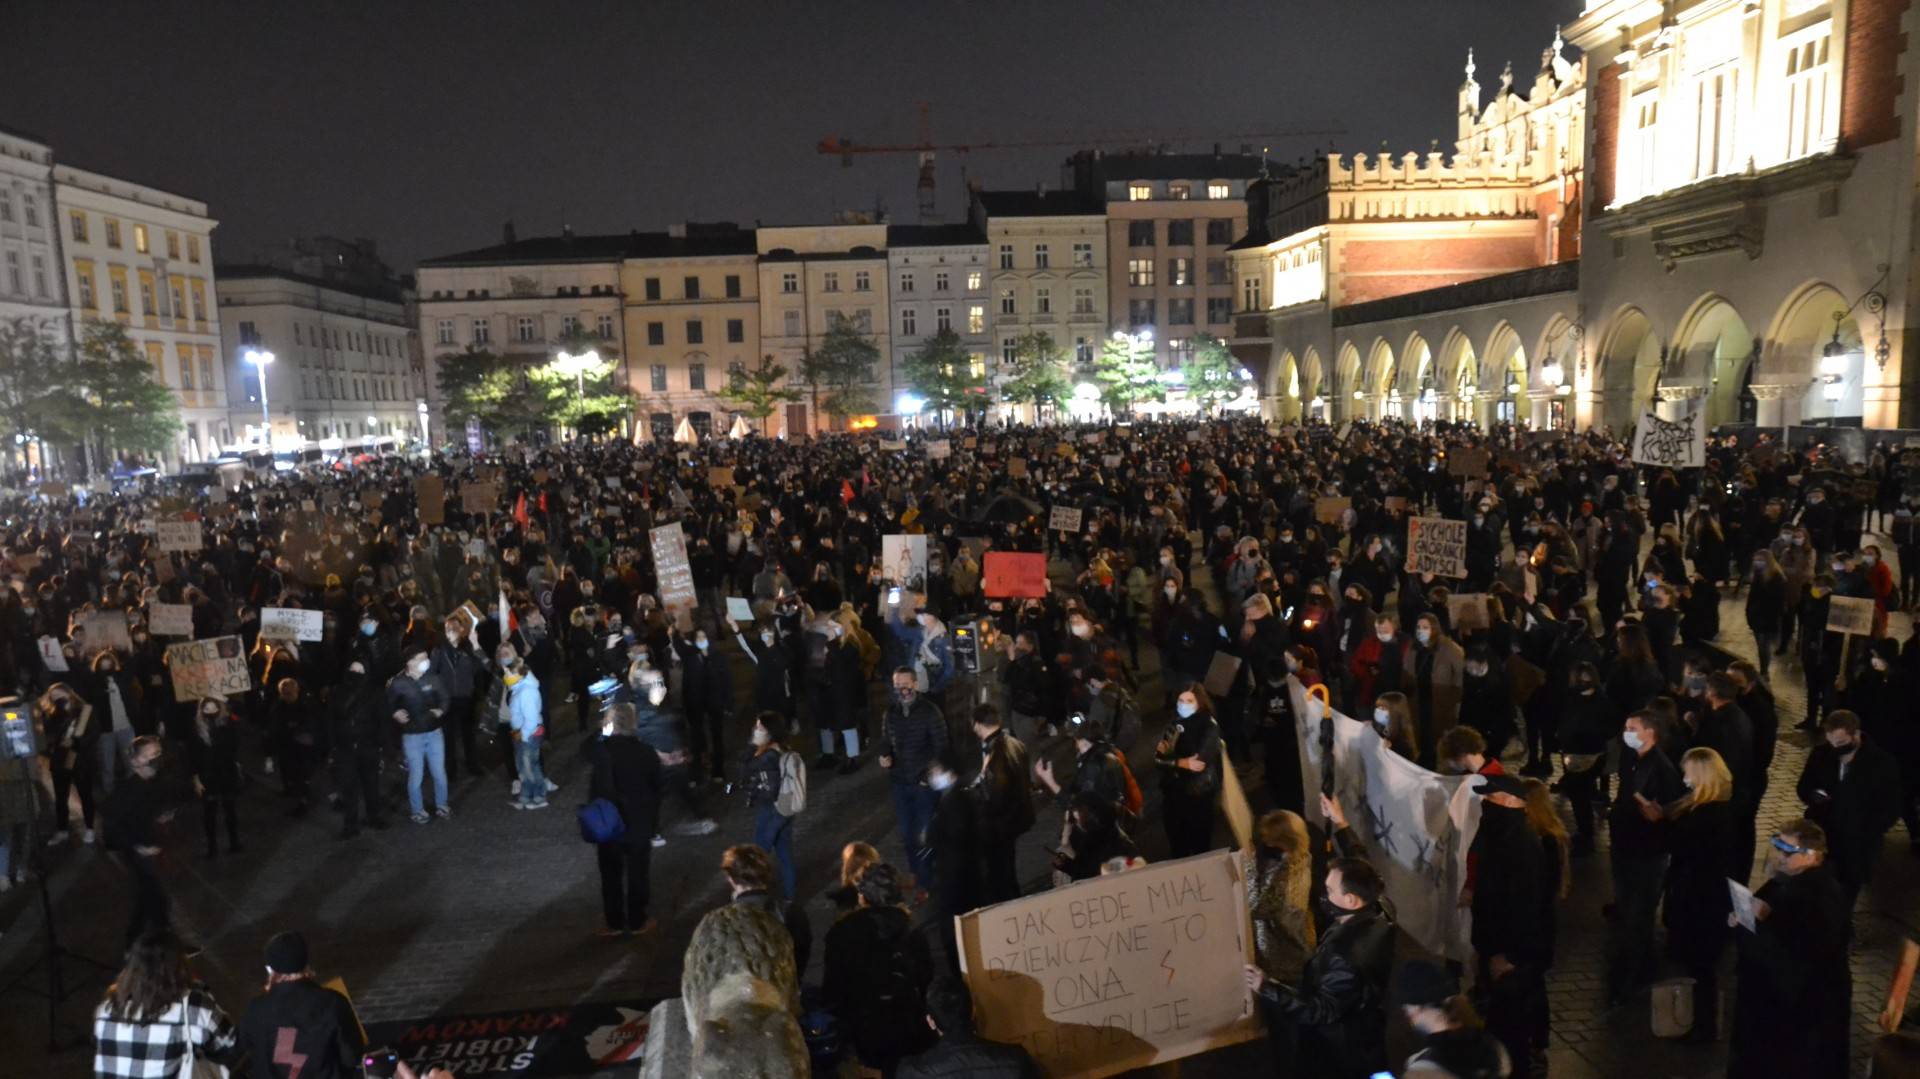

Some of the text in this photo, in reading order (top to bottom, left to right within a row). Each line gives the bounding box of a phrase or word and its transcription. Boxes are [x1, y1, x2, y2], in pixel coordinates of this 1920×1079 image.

[1641, 437, 1696, 464] KOBIET
[1411, 519, 1464, 544] PSYCHOLE
[1411, 537, 1464, 560] IGNORANCI
[170, 642, 218, 664] MACIE
[227, 659, 248, 674] NA
[1004, 908, 1055, 945] JAK
[1147, 873, 1213, 912] MIAŁ
[1162, 914, 1207, 944] TO
[1055, 967, 1128, 1008] ONA
[1010, 997, 1192, 1056] DECYDUJE
[411, 1035, 539, 1060] KOBIET
